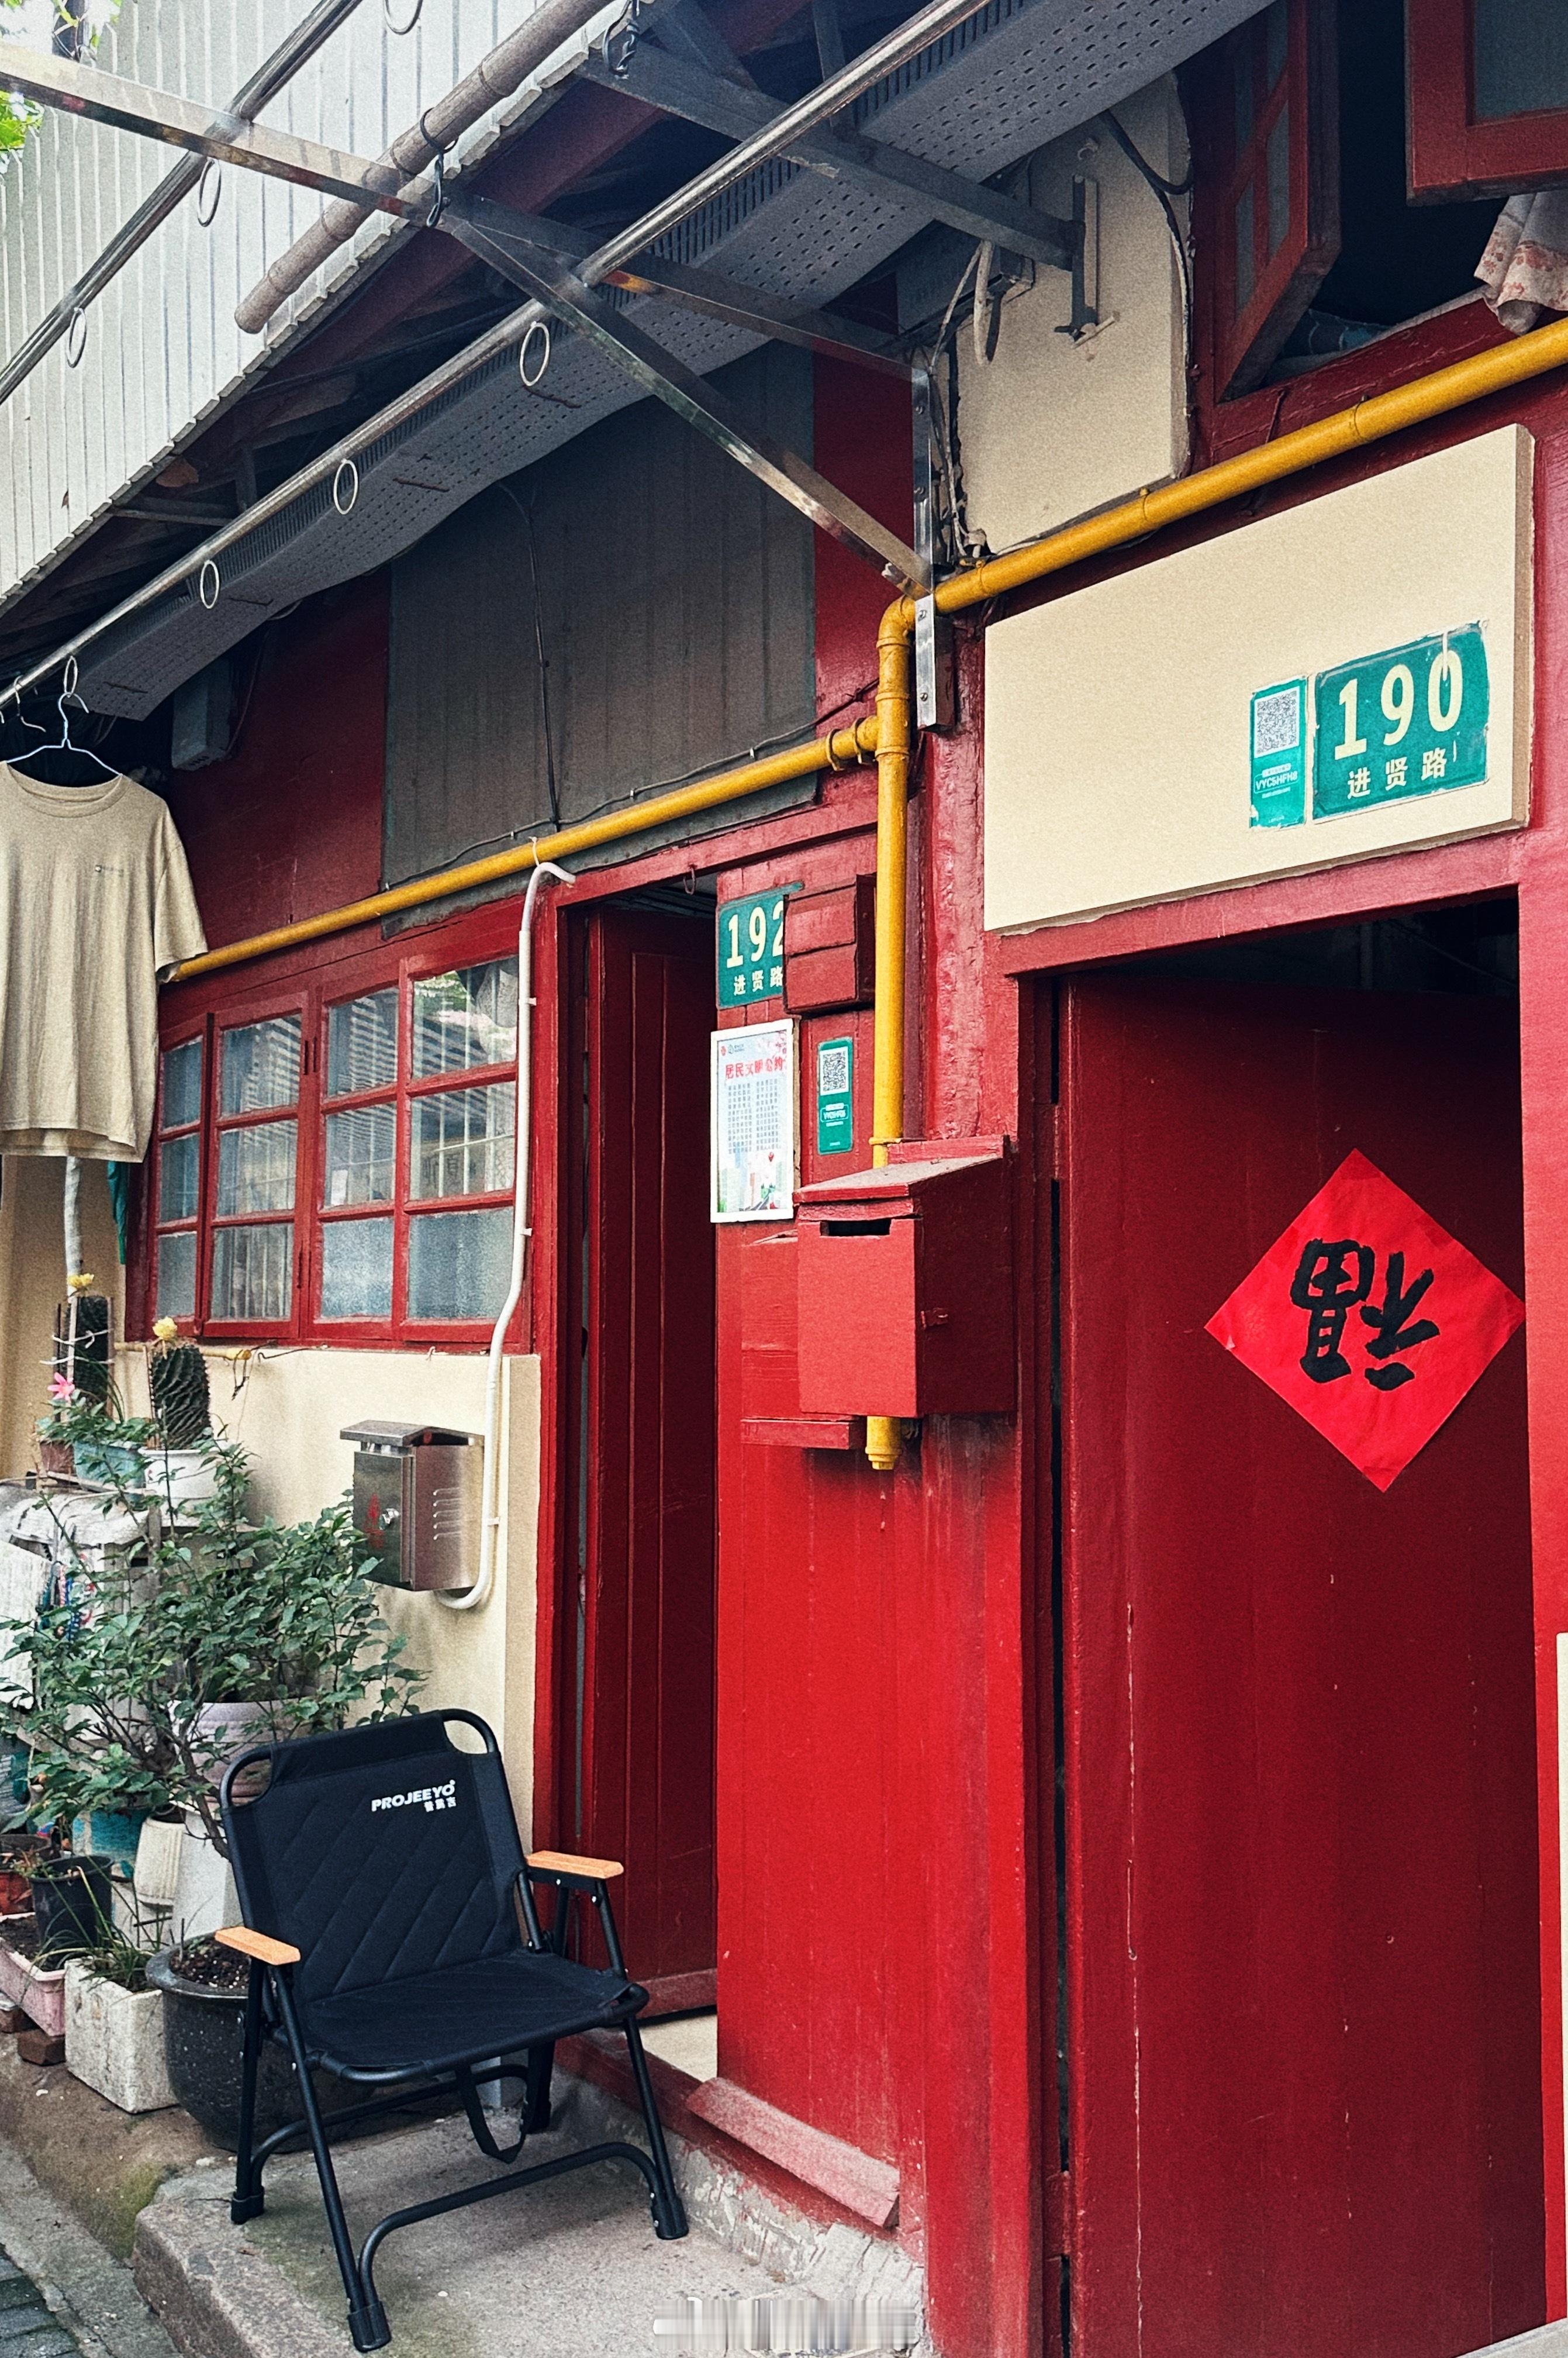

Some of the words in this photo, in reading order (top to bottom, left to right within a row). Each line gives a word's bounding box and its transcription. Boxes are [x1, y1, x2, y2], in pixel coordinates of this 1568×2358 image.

[1335, 650, 1463, 760] 190
[1348, 747, 1447, 799] 进贤路
[727, 901, 783, 968] 192
[734, 966, 783, 996] 进贤路
[726, 1056, 783, 1080] 居民文明公约
[1290, 1237, 1441, 1392] 福
[371, 1784, 455, 1812] PROJEEYO
